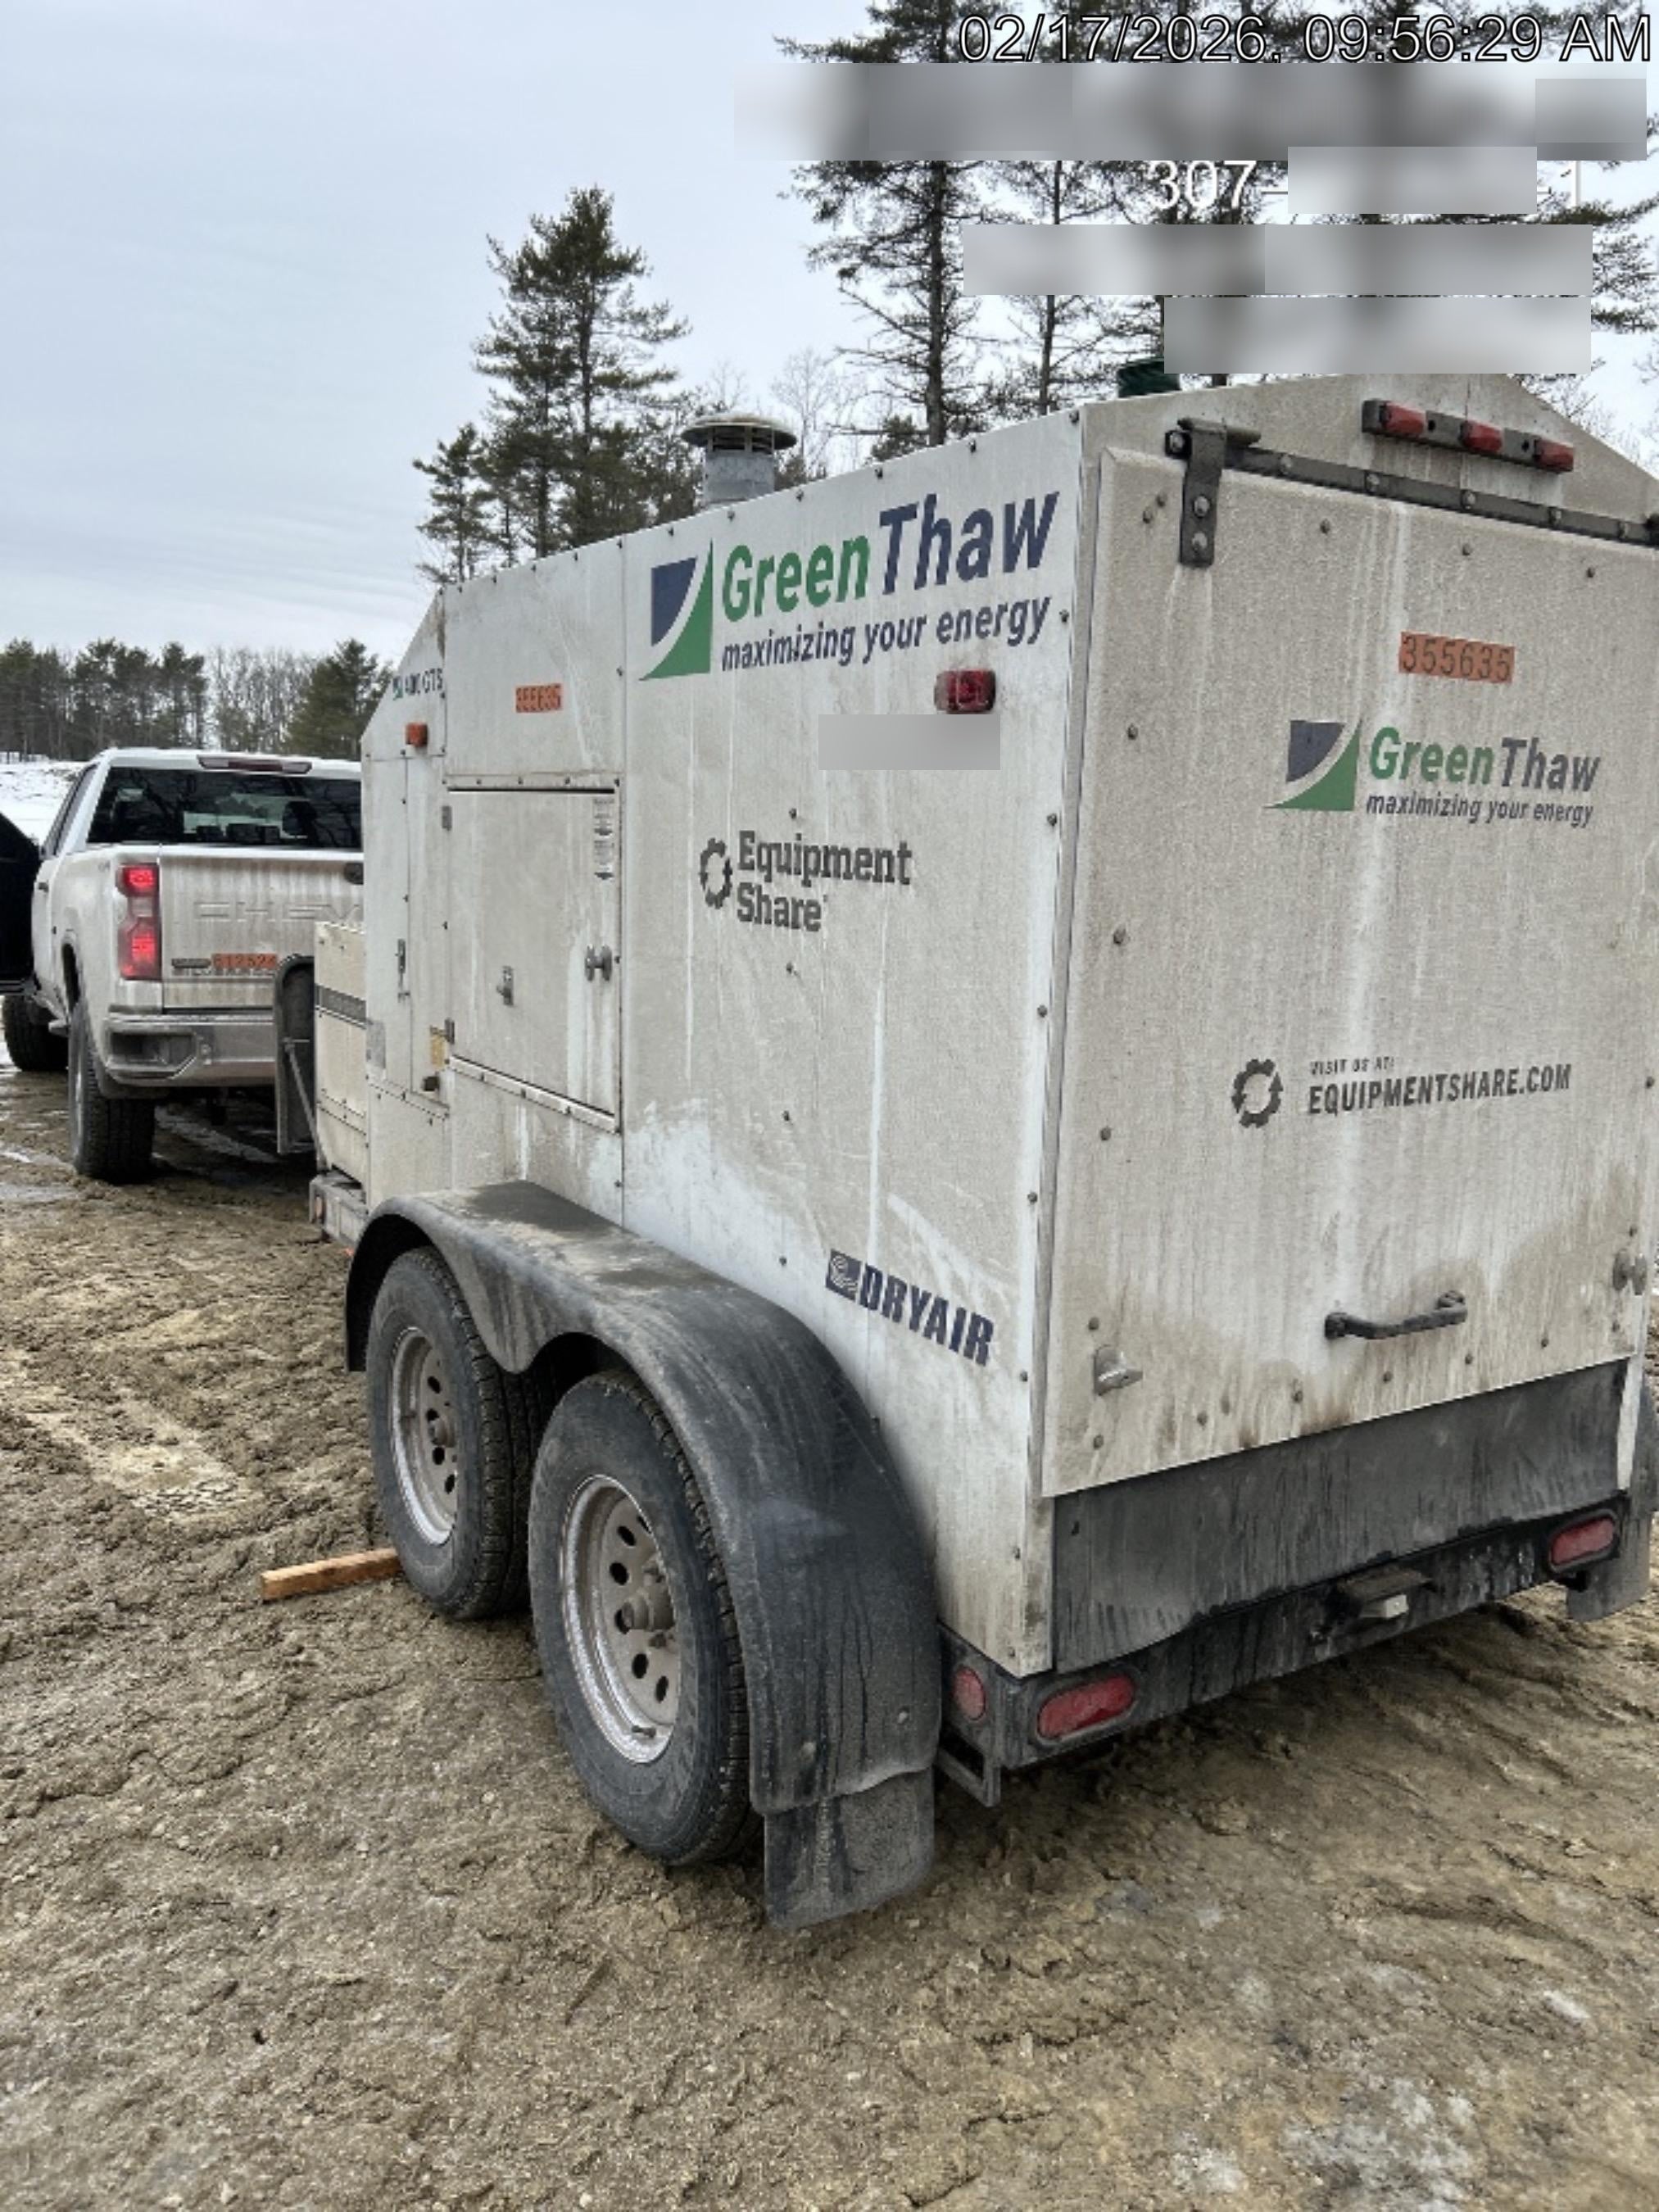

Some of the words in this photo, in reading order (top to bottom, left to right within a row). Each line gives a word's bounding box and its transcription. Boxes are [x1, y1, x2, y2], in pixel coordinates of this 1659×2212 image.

[722, 623, 855, 672] maximizing
[863, 612, 927, 664] your
[936, 596, 1051, 646] energy
[1402, 634, 1512, 683] 355635
[1366, 791, 1479, 824] maximizing
[1487, 797, 1529, 824] your
[1533, 800, 1594, 828] energy
[738, 830, 913, 887] Equipment
[737, 882, 822, 932] Share
[1308, 1063, 1572, 1117] EQUIPMENTSHARE.COM
[1310, 1058, 1348, 1076] VISIT
[1352, 1057, 1371, 1072] US
[859, 1262, 995, 1367] DRYAIR
